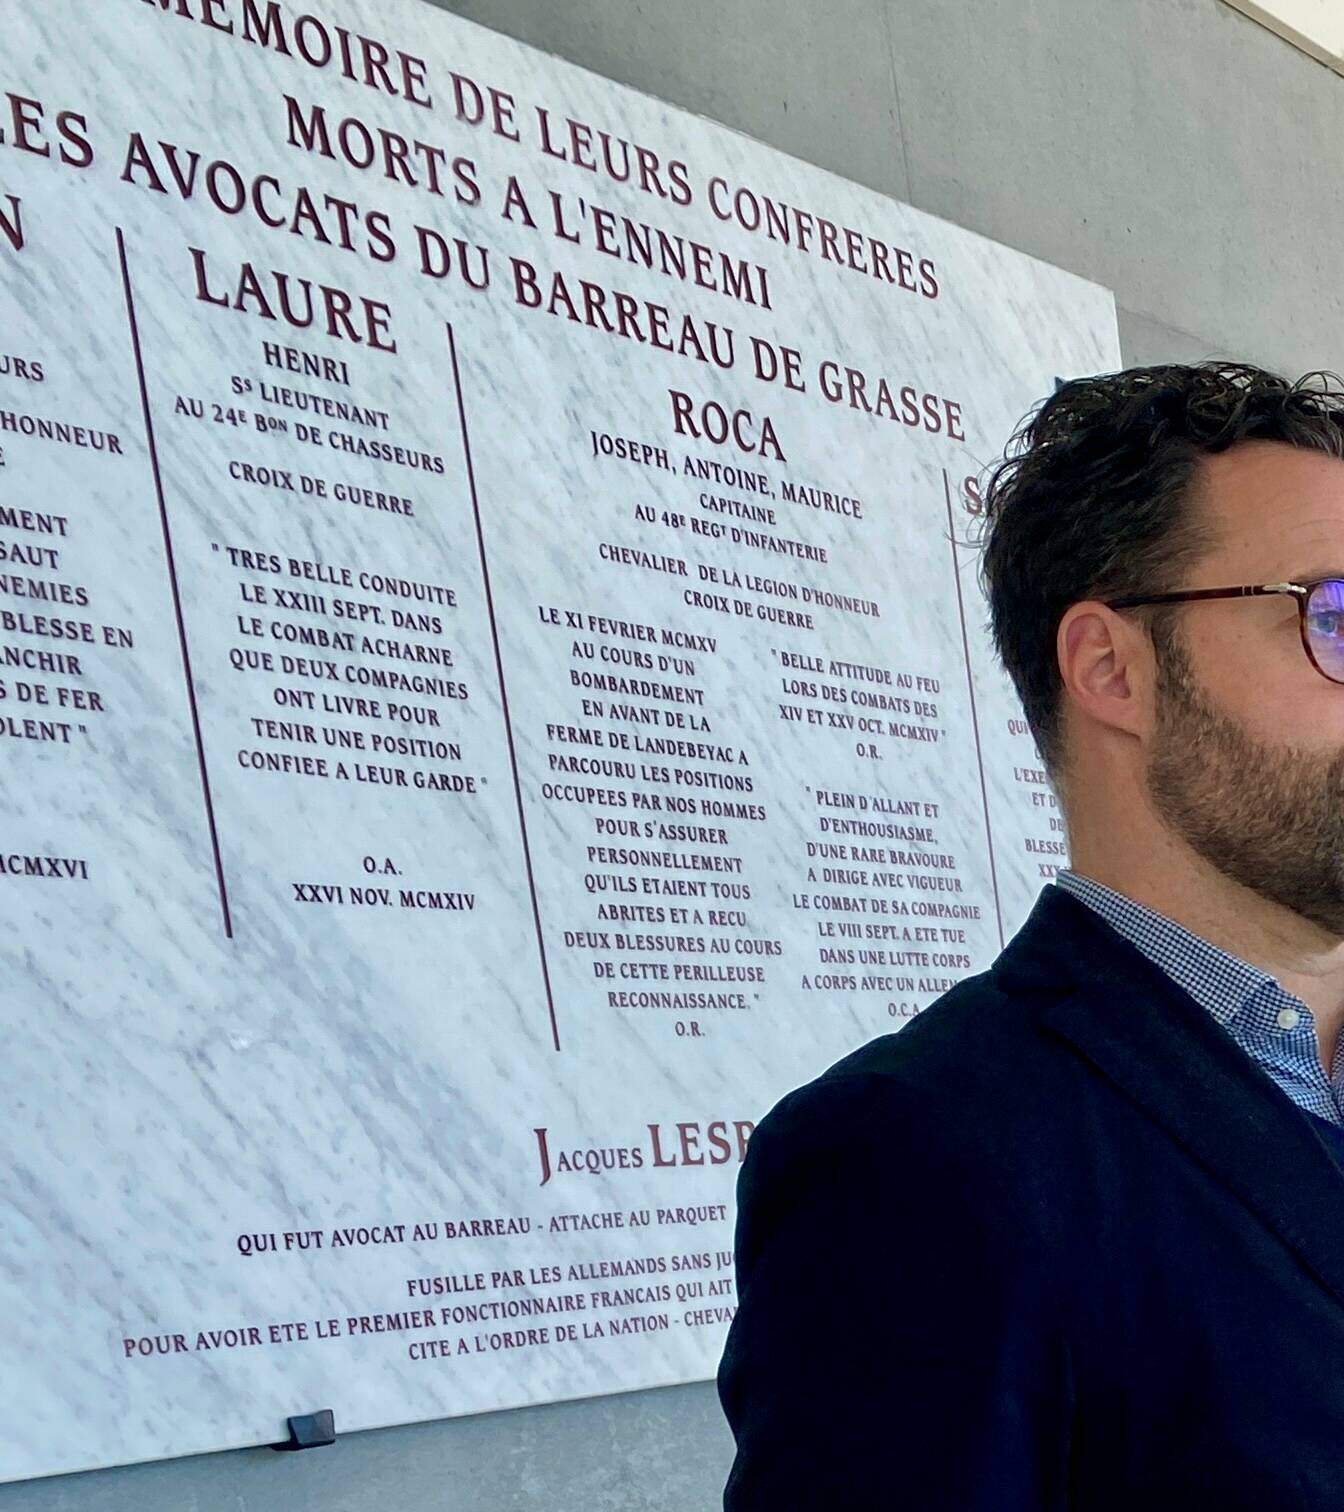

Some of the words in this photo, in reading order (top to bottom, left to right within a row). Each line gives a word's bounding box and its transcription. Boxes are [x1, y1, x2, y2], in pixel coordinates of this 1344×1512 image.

[283, 94, 481, 206] MORTS
[502, 176, 537, 229] A
[548, 191, 771, 310] L'ENNEMI
[449, 72, 520, 142] DE
[535, 106, 692, 205] LEURS
[709, 178, 938, 298] CONFRERES
[0, 93, 93, 168] ES
[121, 133, 395, 262] AVOCATS
[414, 225, 489, 290] DU
[509, 257, 734, 368] BARREAU
[749, 336, 805, 392] DE
[820, 361, 965, 441] GRASSE
[188, 247, 397, 354] LAURE
[262, 341, 349, 386] HENRI
[259, 382, 388, 430] LIEUTENANT
[668, 389, 787, 462] ROCA
[175, 396, 203, 418] AU
[295, 423, 323, 446] DE
[329, 432, 444, 474] CHASSEURS
[229, 461, 294, 491] CROIX
[300, 476, 327, 498] DE
[334, 484, 414, 516] GUERRE
[700, 494, 776, 525] CAPITAINE
[782, 481, 862, 519] MAURICE
[635, 504, 655, 522] AU
[731, 528, 827, 563] D'INFANTERIE
[226, 547, 281, 573] TRES
[288, 559, 353, 587] BELLE
[359, 573, 456, 607] CONDUITE
[599, 543, 688, 576] CHEVALIER
[698, 565, 718, 583] DE
[722, 570, 742, 588] LA
[745, 575, 797, 599] LEGION
[802, 587, 880, 617] D'HONNEUR
[2, 611, 95, 643] BLESSE
[102, 626, 133, 648] EN
[240, 583, 267, 604] LE
[273, 589, 326, 614] XXIII
[391, 610, 442, 634] DANS
[539, 606, 560, 625] LE
[565, 611, 583, 629] XI
[588, 616, 657, 643] FEVRIER
[661, 630, 716, 652] MCMXV
[684, 590, 730, 613] CROIX
[734, 600, 753, 617] DE
[757, 605, 813, 630] GUERRE
[238, 616, 264, 637] LE
[271, 622, 354, 651] COMBAT
[362, 637, 453, 667] ACHARNE
[573, 641, 594, 658] AU
[600, 646, 653, 669] COURS
[658, 656, 694, 675] D'UN
[230, 649, 274, 671] QUE
[281, 656, 339, 680] DEUX
[345, 666, 468, 700] COMPAGNIES
[570, 670, 703, 705] BOMBARDEMENT
[781, 652, 824, 673] BELLE
[830, 661, 892, 685] ATTITUDE
[897, 673, 912, 688] AU
[916, 677, 939, 693] FEU
[16, 682, 48, 705] DE
[57, 688, 104, 711] FER
[274, 688, 315, 709] ONT
[322, 694, 381, 718] LIVRE
[387, 703, 440, 727] POUR
[582, 699, 603, 717] EN
[610, 704, 659, 725] AVANT
[664, 711, 685, 728] DE
[689, 715, 711, 732] LA
[251, 718, 317, 743] TENIR
[322, 728, 365, 750] UNE
[371, 734, 461, 760] POSITION
[546, 724, 603, 747] FERME
[608, 732, 630, 750] DE
[739, 751, 748, 765] A
[238, 750, 328, 777] CONFIEE
[336, 762, 349, 780] A
[355, 764, 408, 786] LEUR
[413, 772, 476, 793] GARDE
[548, 754, 635, 779] PARCOURU
[641, 765, 670, 783] LES
[674, 769, 753, 792] POSITIONS
[542, 784, 627, 807] OCCUPEES
[632, 793, 662, 810] PAR
[665, 796, 696, 814] NOS
[701, 800, 766, 820] HOMMES
[595, 818, 641, 837] POUR
[645, 820, 728, 844] S'ASSURER
[587, 847, 742, 873] PERSONNELLEMENT
[292, 884, 343, 904] XXVI
[399, 890, 474, 910] MCMXIV
[585, 874, 637, 893] QU'ILS
[642, 878, 706, 897] ETAIENT
[711, 883, 750, 899] TOUS
[598, 904, 665, 922] ABRITES
[670, 908, 688, 924] ET
[694, 910, 704, 924] A
[564, 932, 611, 949] DEUX
[615, 934, 705, 952] BLESSURES
[711, 939, 730, 953] AU
[735, 939, 782, 955] COURS
[593, 962, 615, 978] DE
[620, 963, 669, 980] CETTE
[673, 965, 765, 982] PERILLEUSE
[238, 1234, 277, 1256] QUI
[283, 1231, 323, 1250] FUT
[332, 1225, 405, 1247] AVOCAT
[413, 1223, 437, 1241] AU
[445, 1218, 530, 1238] BARREAU
[550, 1212, 624, 1232] ATTACHE
[630, 1211, 649, 1227] AU
[657, 1206, 726, 1225] PARQUET
[407, 1273, 486, 1296] FUSILLE
[491, 1270, 525, 1288] PAR
[530, 1267, 561, 1284] LES
[568, 1257, 666, 1281] ALLEMANDS
[672, 1253, 711, 1271] SANS
[123, 1335, 188, 1357] POUR
[196, 1327, 262, 1350] AVOIR
[268, 1323, 308, 1343] ETE
[315, 1320, 340, 1338] LE
[347, 1310, 436, 1335] PREMIER
[441, 1294, 586, 1325] FONCTIONNAIRE
[591, 1285, 670, 1308] FRANCAIS
[676, 1282, 703, 1302] QUI
[709, 1280, 731, 1296] AIT
[409, 1340, 450, 1360] CITE
[458, 1338, 470, 1355] A
[475, 1328, 549, 1352] L'ORDRE
[555, 1325, 578, 1342] DE
[583, 1322, 604, 1338] LA
[609, 1314, 668, 1336] NATION
